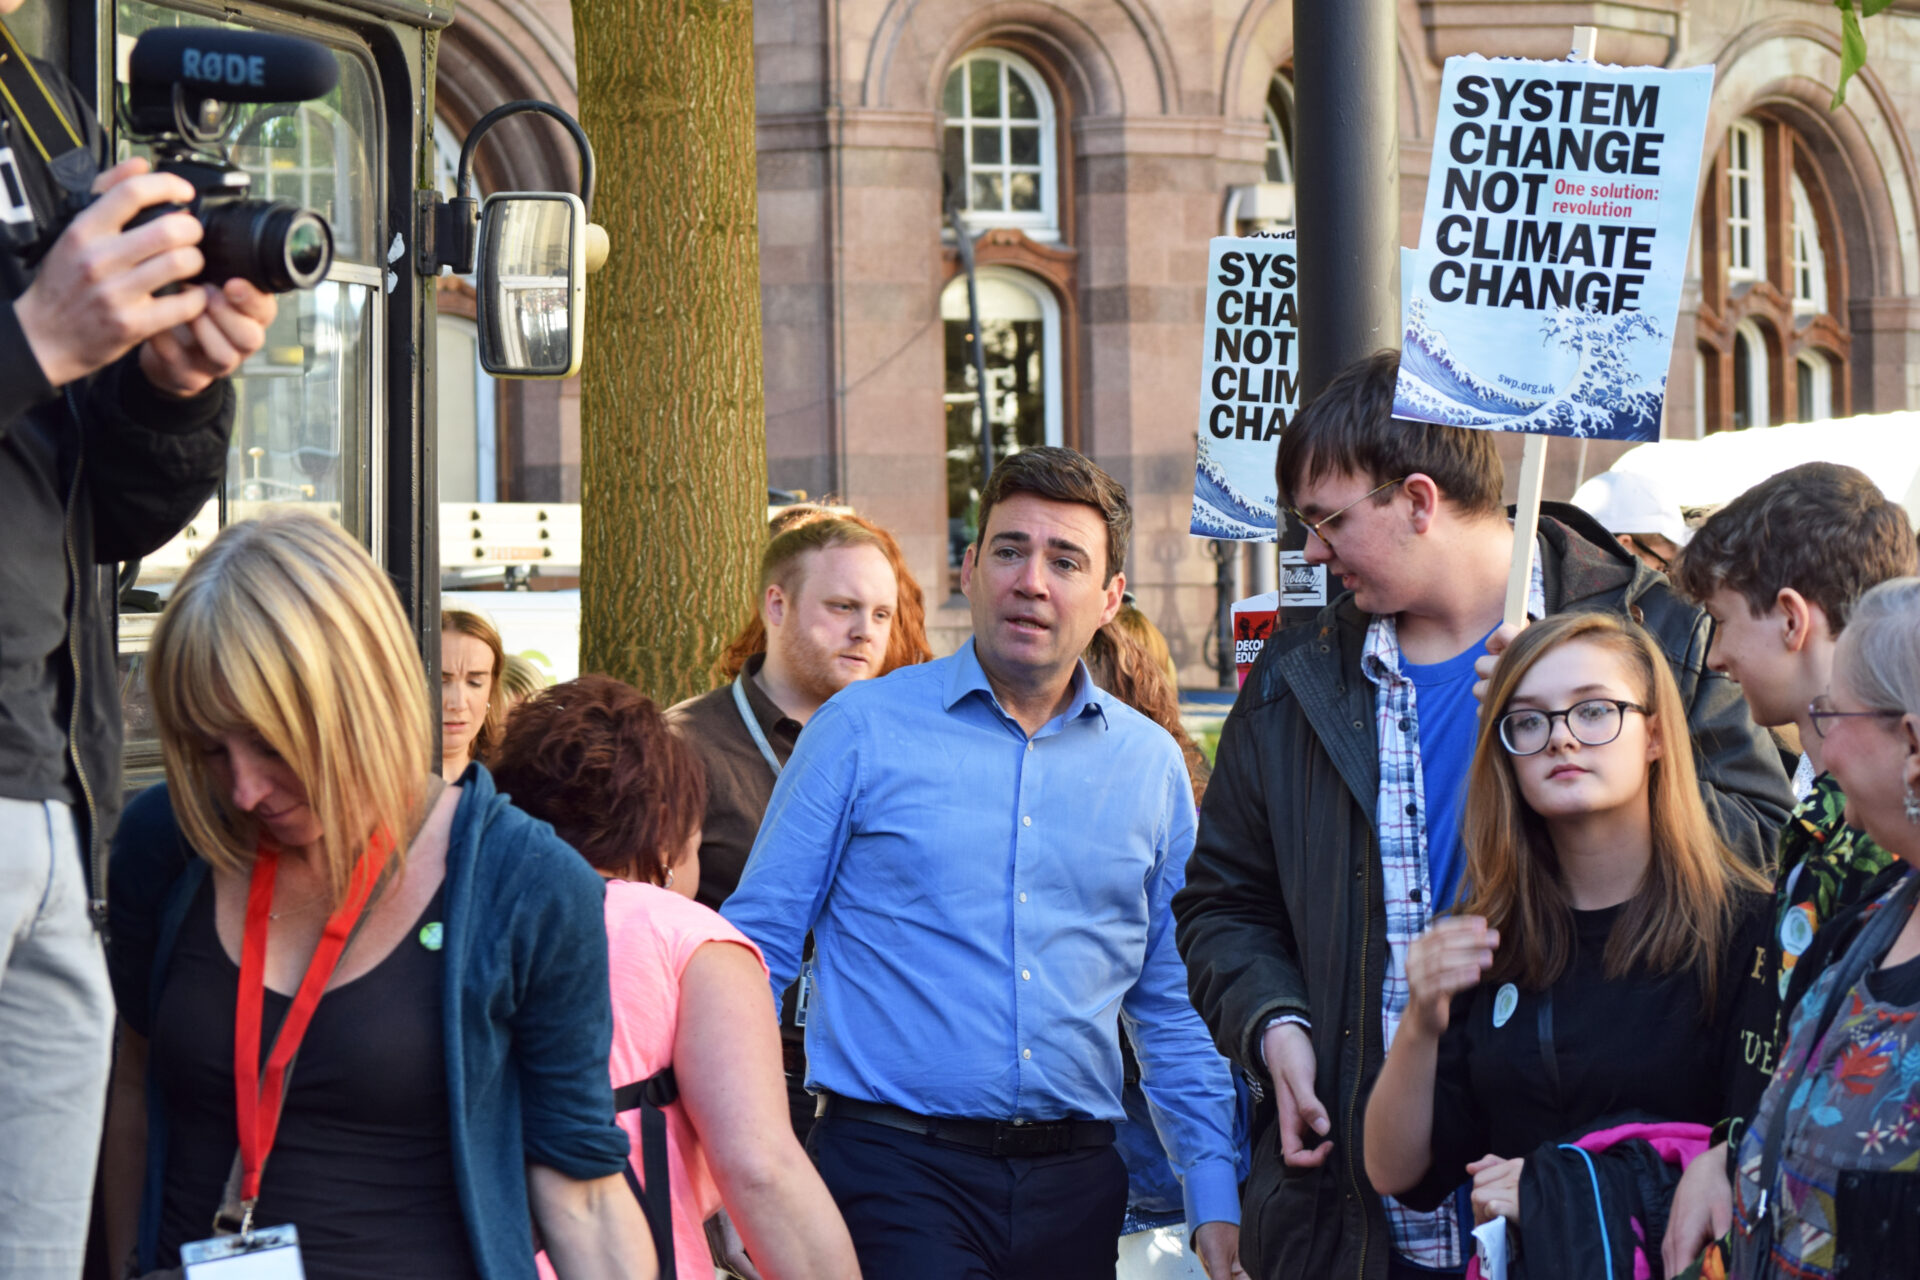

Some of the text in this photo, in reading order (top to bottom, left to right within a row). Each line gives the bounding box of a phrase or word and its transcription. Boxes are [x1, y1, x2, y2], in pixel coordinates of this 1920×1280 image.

[183, 47, 265, 87] RØDE
[1453, 75, 1660, 128] SYSTEM
[1450, 122, 1664, 176] CHANGE
[1442, 167, 1548, 215] NOT
[1552, 200, 1632, 218] revolution
[1554, 178, 1659, 200] One solution:
[1436, 214, 1656, 270] CLIMATE
[1429, 260, 1645, 315] CHANGE
[1215, 327, 1296, 366] NOT
[1497, 374, 1555, 395] swp.org.uk
